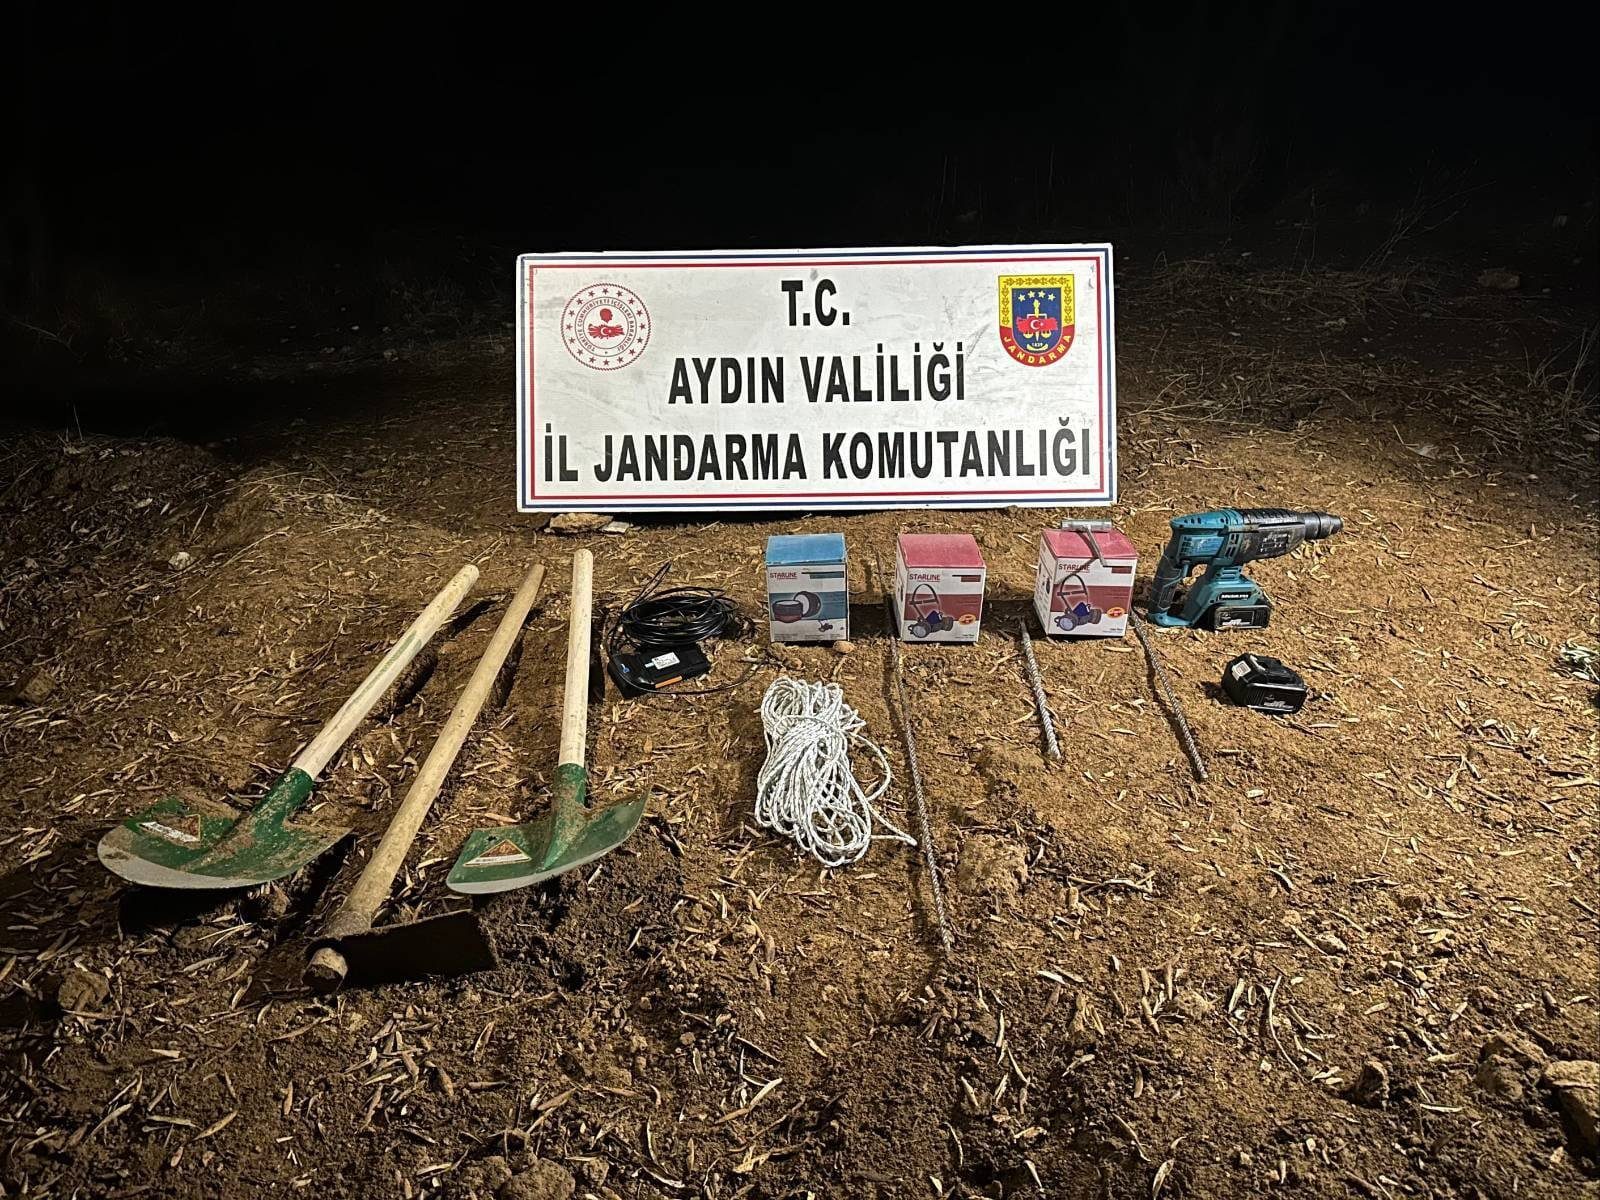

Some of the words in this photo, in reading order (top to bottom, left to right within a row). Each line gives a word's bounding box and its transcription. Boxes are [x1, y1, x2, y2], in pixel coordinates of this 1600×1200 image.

[781, 279, 850, 326] T.C.
[668, 357, 785, 404] AYDIN
[800, 342, 965, 403] VALİLİĞİ
[1003, 335, 1071, 364] JANDARMA
[544, 423, 579, 482] İL
[594, 433, 807, 482] JANDARMA
[822, 417, 1090, 481] KOMUTANLIĞI
